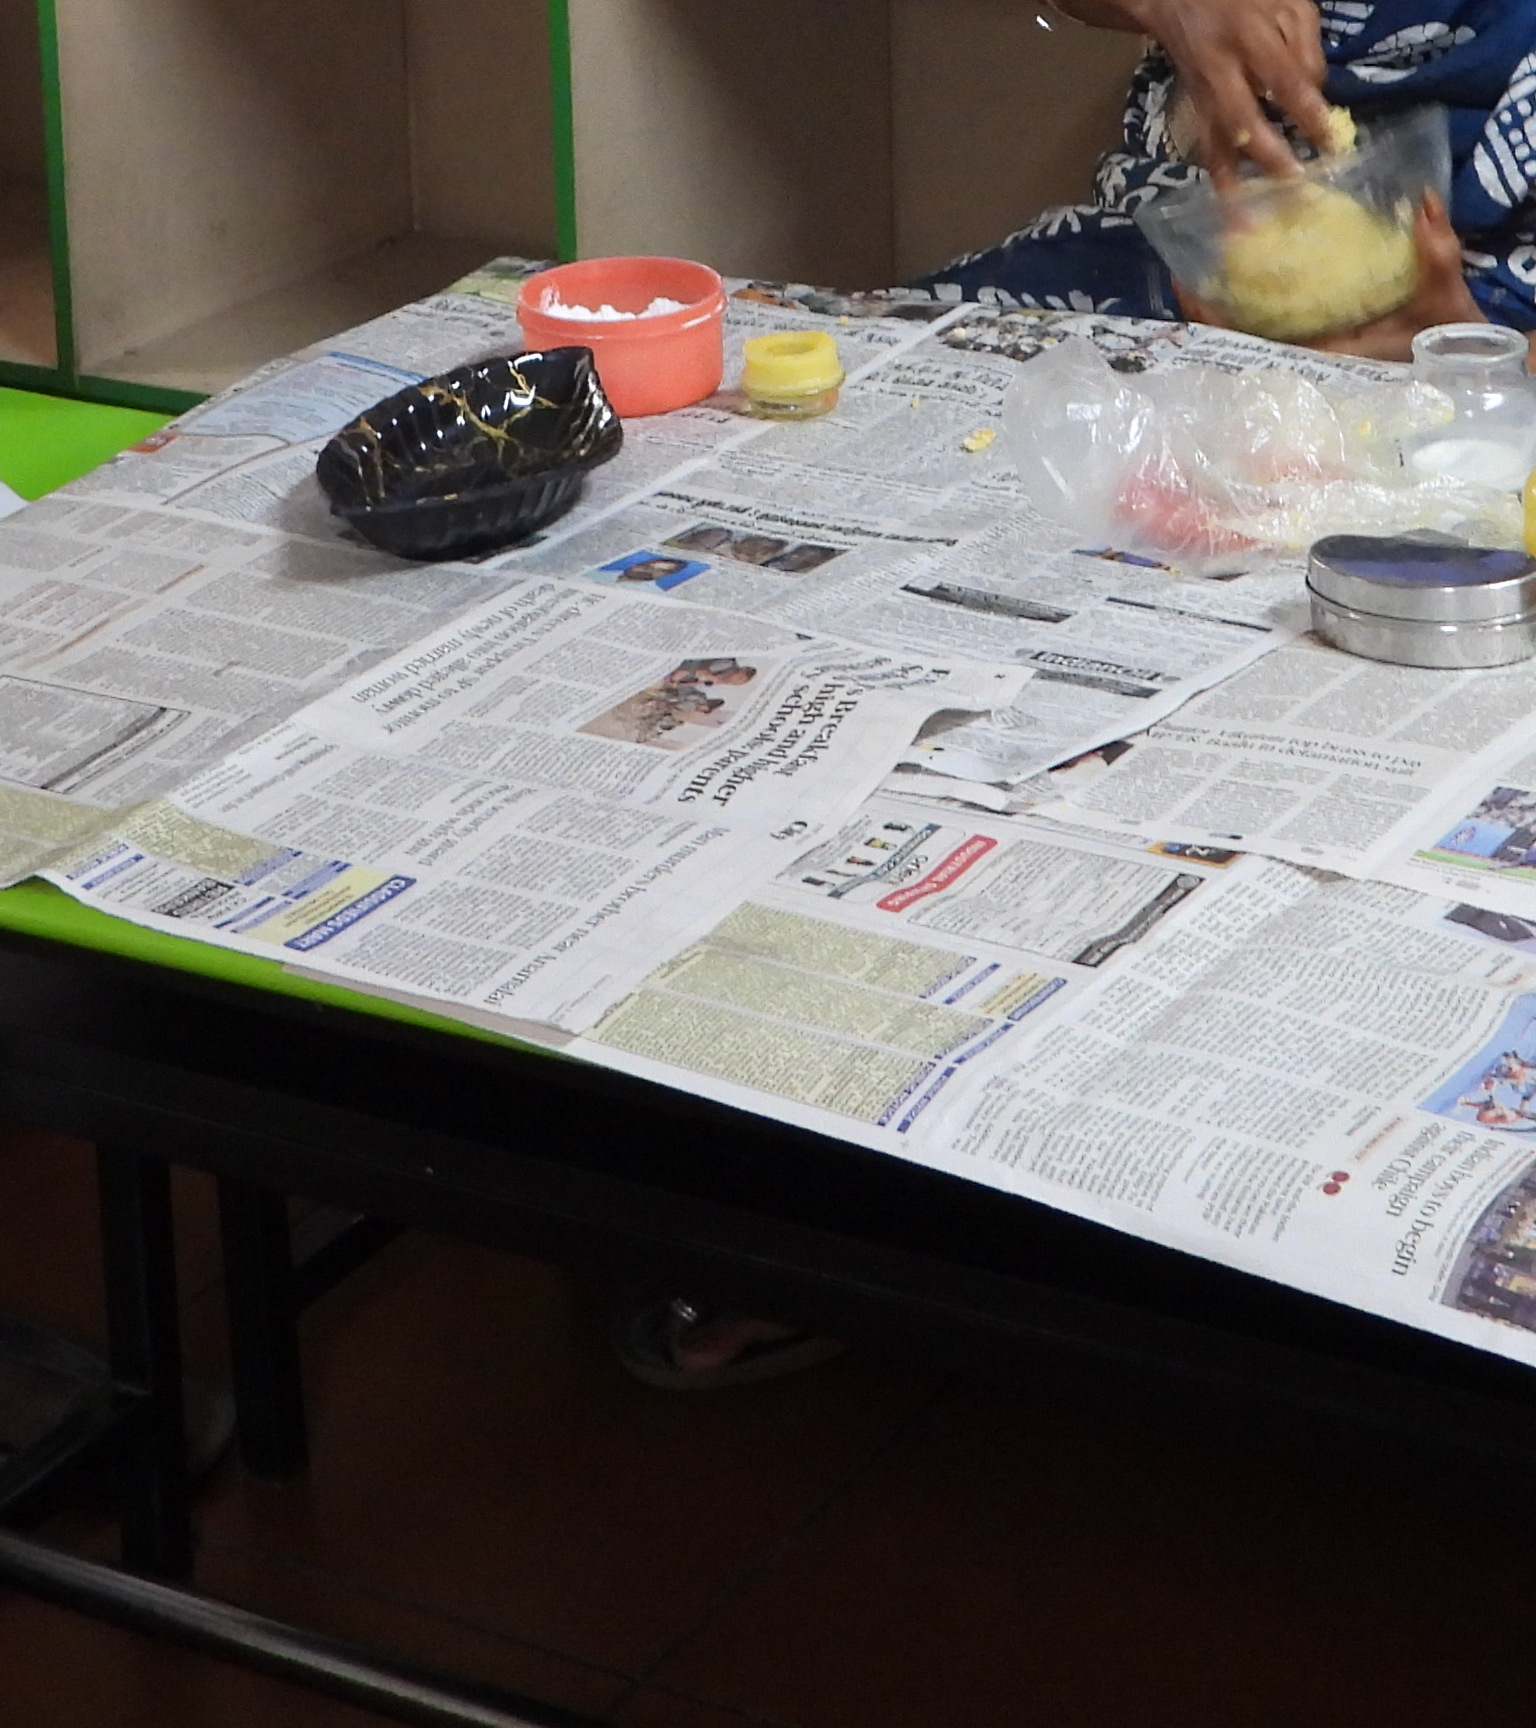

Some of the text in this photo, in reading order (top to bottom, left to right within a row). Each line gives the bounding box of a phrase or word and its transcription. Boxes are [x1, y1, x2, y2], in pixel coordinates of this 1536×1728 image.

[798, 682, 845, 726] high
[767, 728, 806, 760] and
[772, 699, 859, 778] Breakfast
[676, 747, 750, 803] parents
[1391, 1219, 1435, 1276] begin
